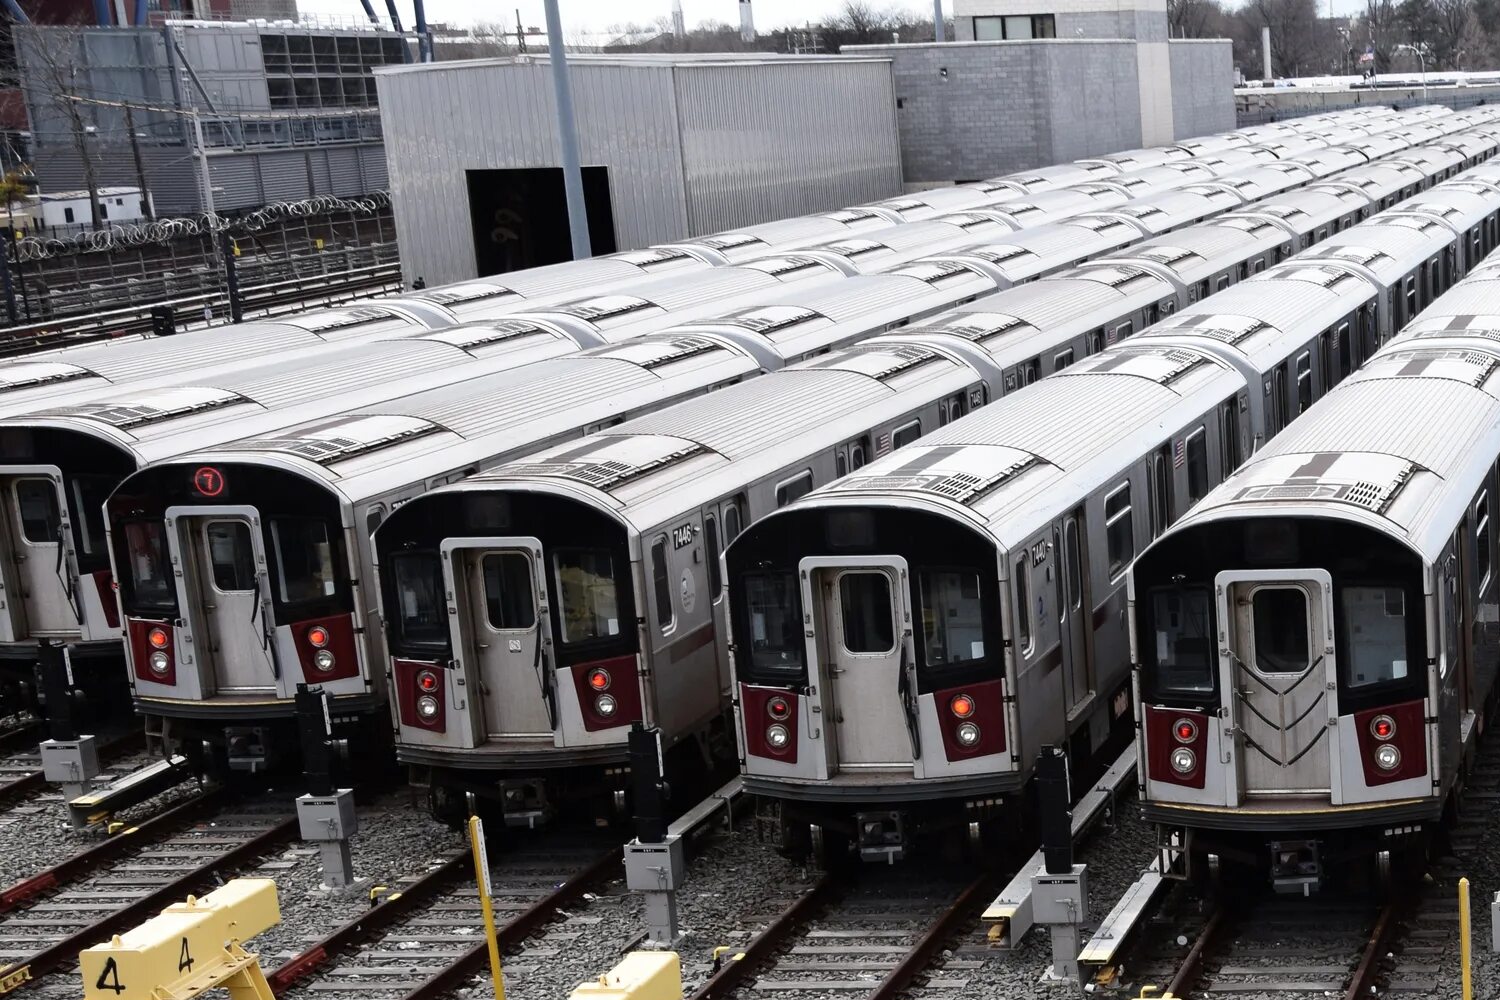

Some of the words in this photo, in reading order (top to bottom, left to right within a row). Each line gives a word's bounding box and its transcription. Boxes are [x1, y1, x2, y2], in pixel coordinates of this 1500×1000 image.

[673, 525, 692, 549] 7446
[178, 937, 195, 974] 4
[96, 957, 126, 995] 4
